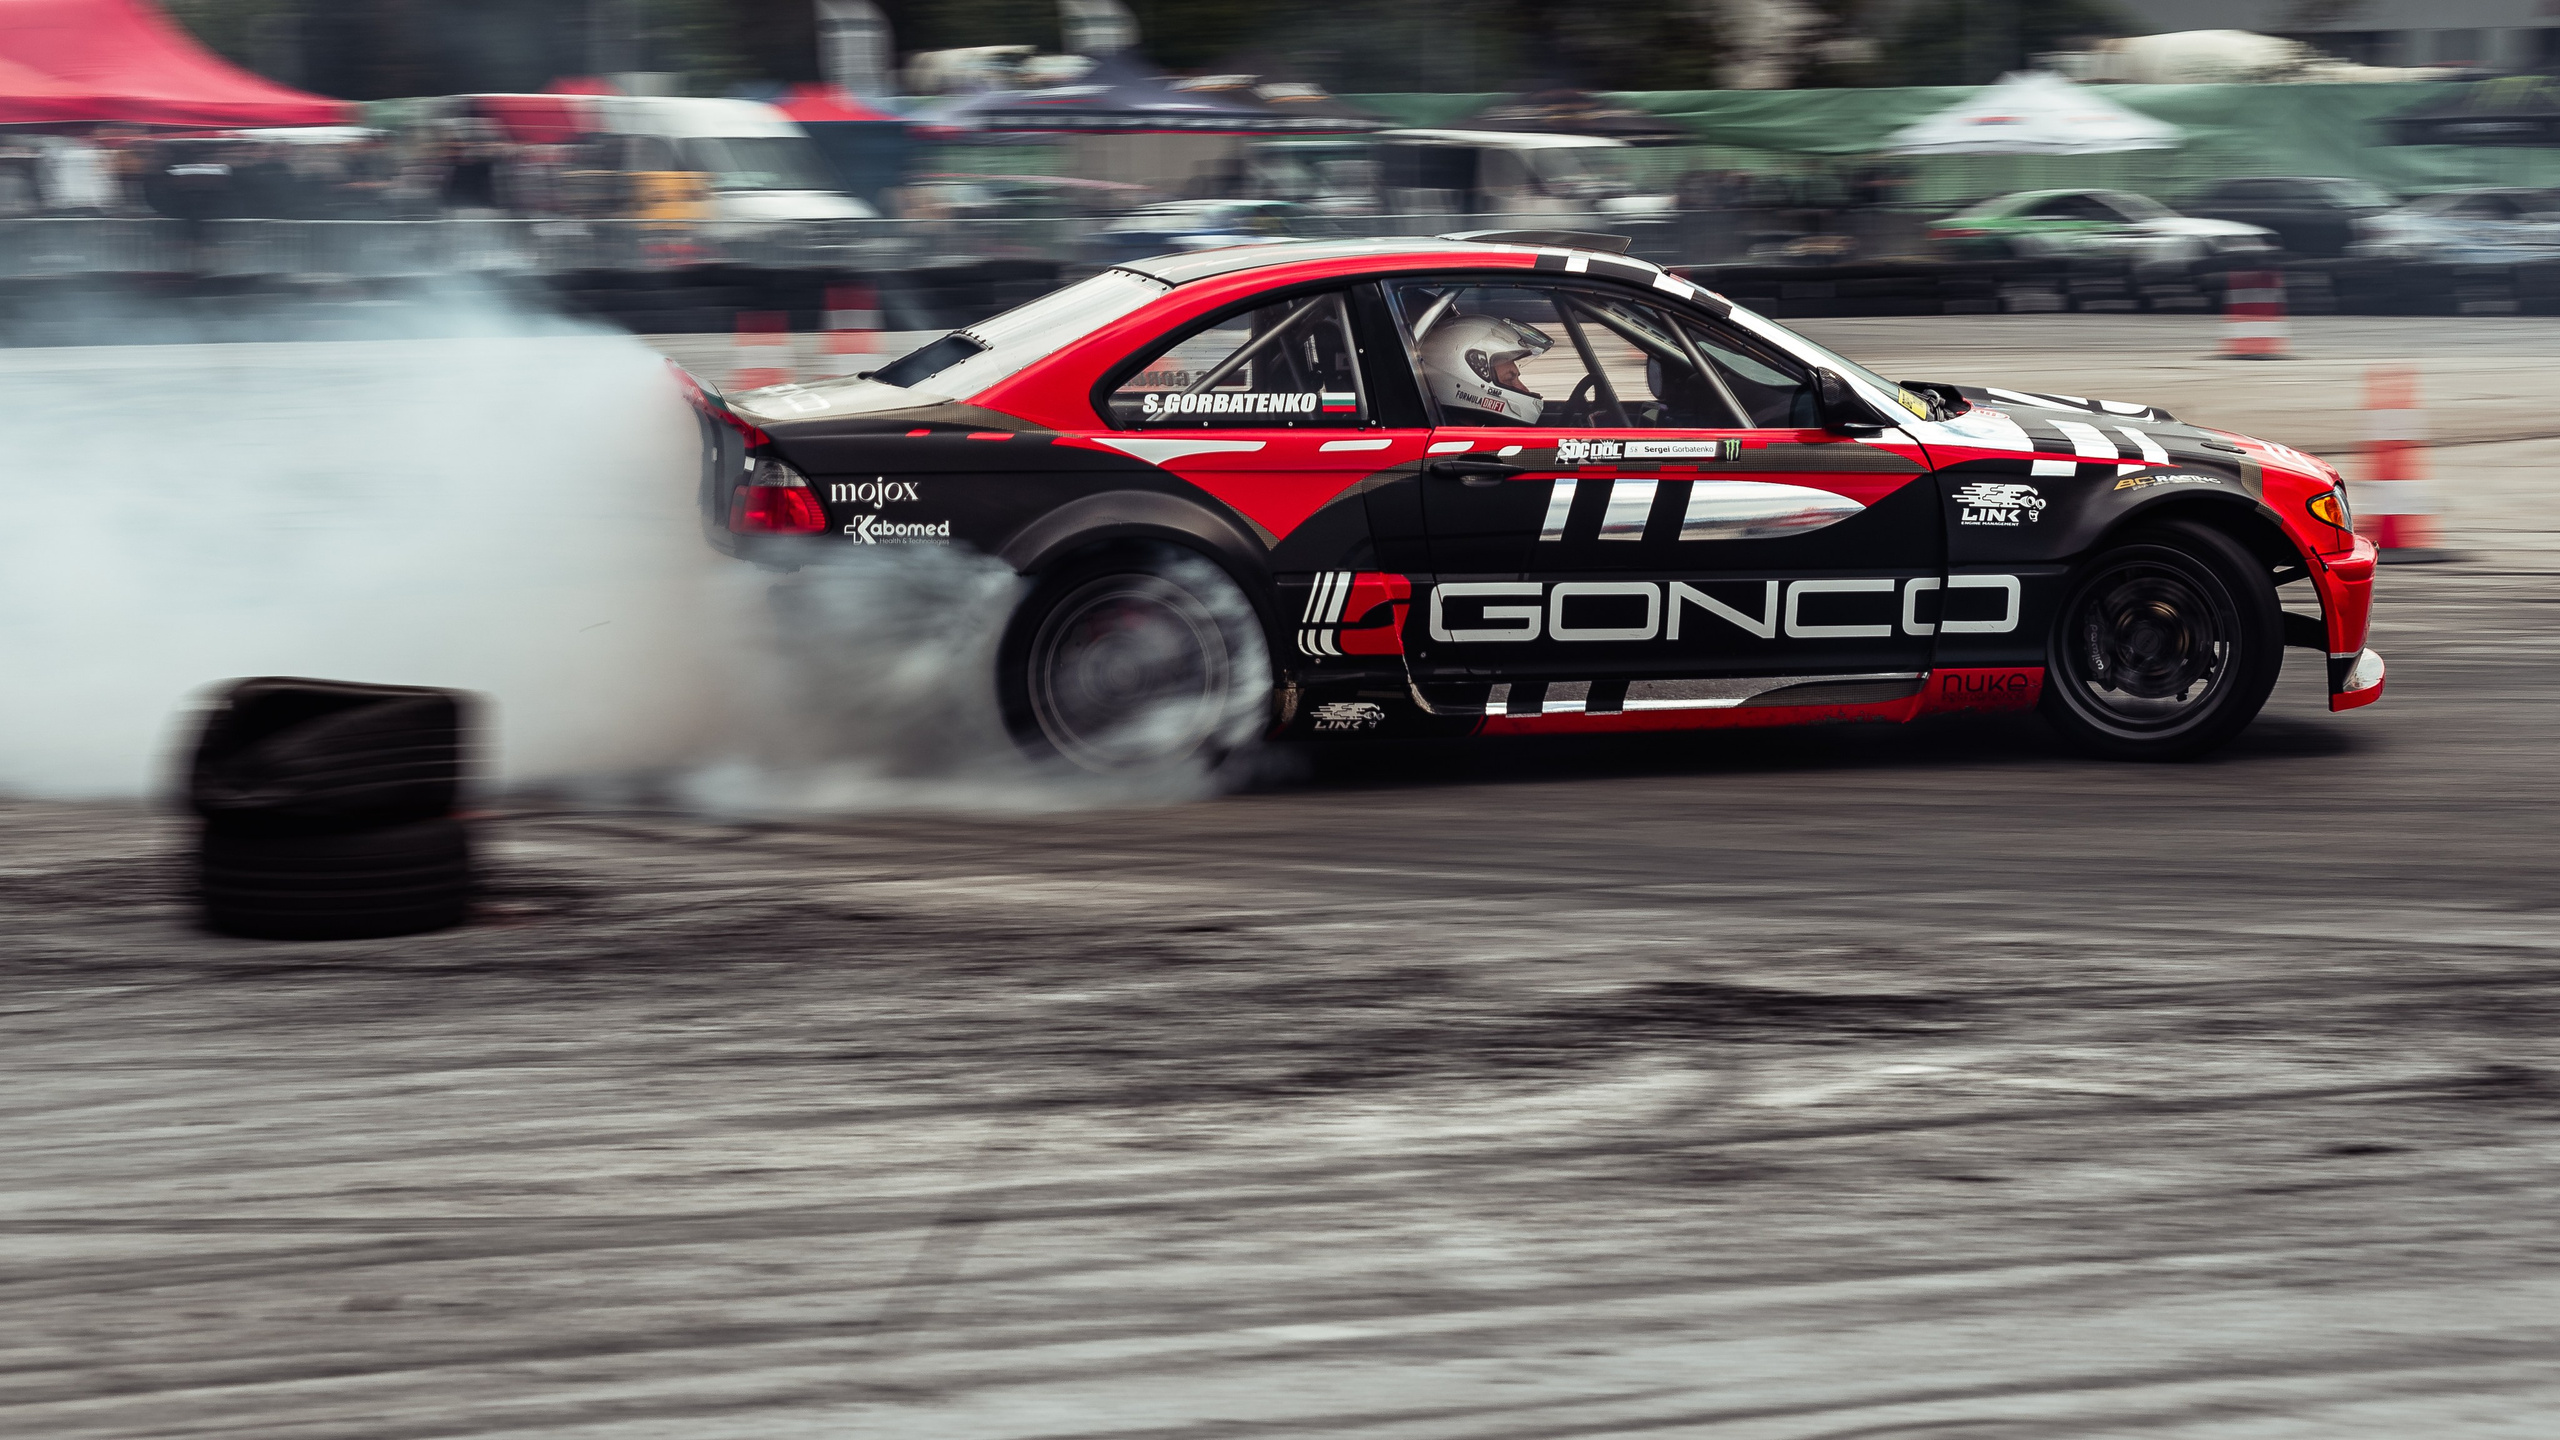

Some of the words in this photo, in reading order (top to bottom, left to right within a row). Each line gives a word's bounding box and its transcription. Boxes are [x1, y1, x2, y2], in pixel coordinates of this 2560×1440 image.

[1143, 393, 1317, 413] S.GORBATENKO
[1456, 390, 1483, 405] FORMULA
[1482, 398, 1504, 412] DRIFT
[1644, 446, 1671, 454] Sergei
[1672, 445, 1714, 453] Gorbatenko
[831, 476, 918, 509] mojox
[2114, 476, 2155, 490] BC
[1961, 508, 2021, 522] LINK
[856, 515, 950, 544] Kabomed
[880, 537, 900, 545] Health
[909, 537, 950, 546] Technologies
[1429, 574, 2021, 641] GONCO
[1942, 673, 2028, 692] nuke
